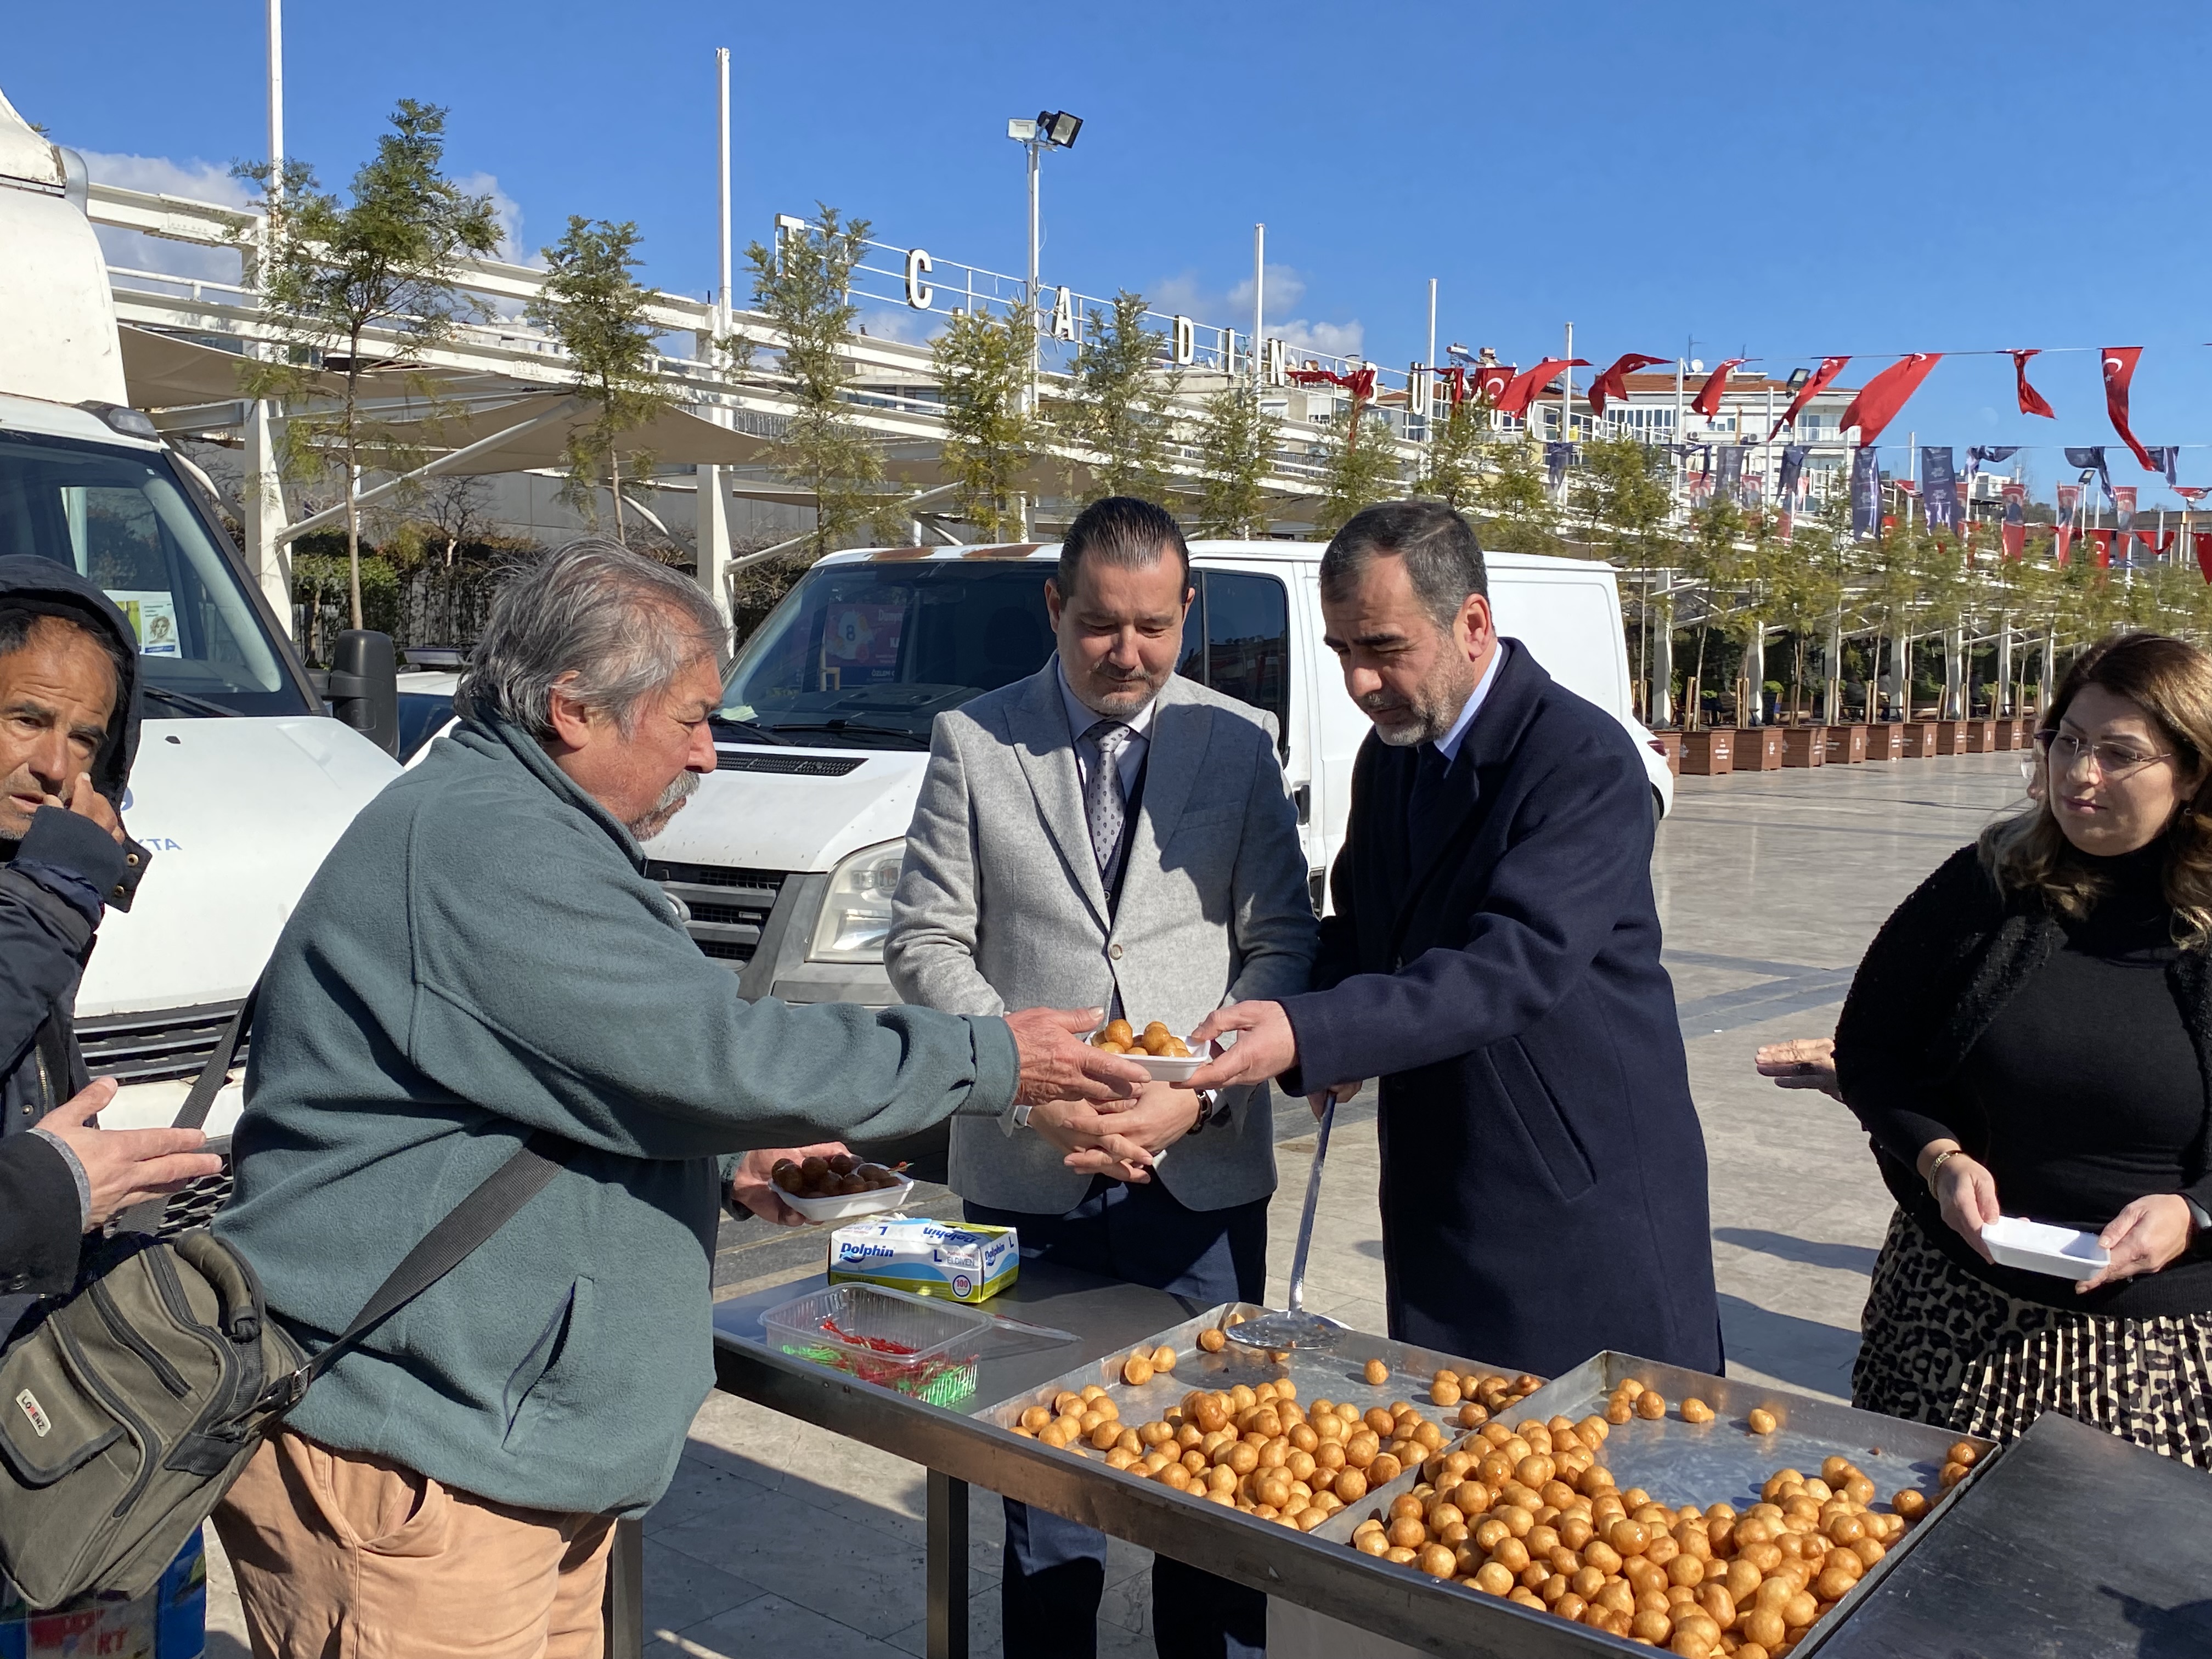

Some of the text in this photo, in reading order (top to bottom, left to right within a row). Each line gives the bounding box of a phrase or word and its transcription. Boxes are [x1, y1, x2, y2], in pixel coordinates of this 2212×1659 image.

[1051, 285, 1286, 387] ADIN
[846, 624, 856, 641] 8
[923, 1227, 977, 1243] Dolphin
[1008, 1235, 1014, 1249] L
[840, 1242, 895, 1258] Dolphin
[934, 1249, 943, 1262] L
[984, 1242, 1005, 1261] Dolphin
[956, 1279, 968, 1288] 100
